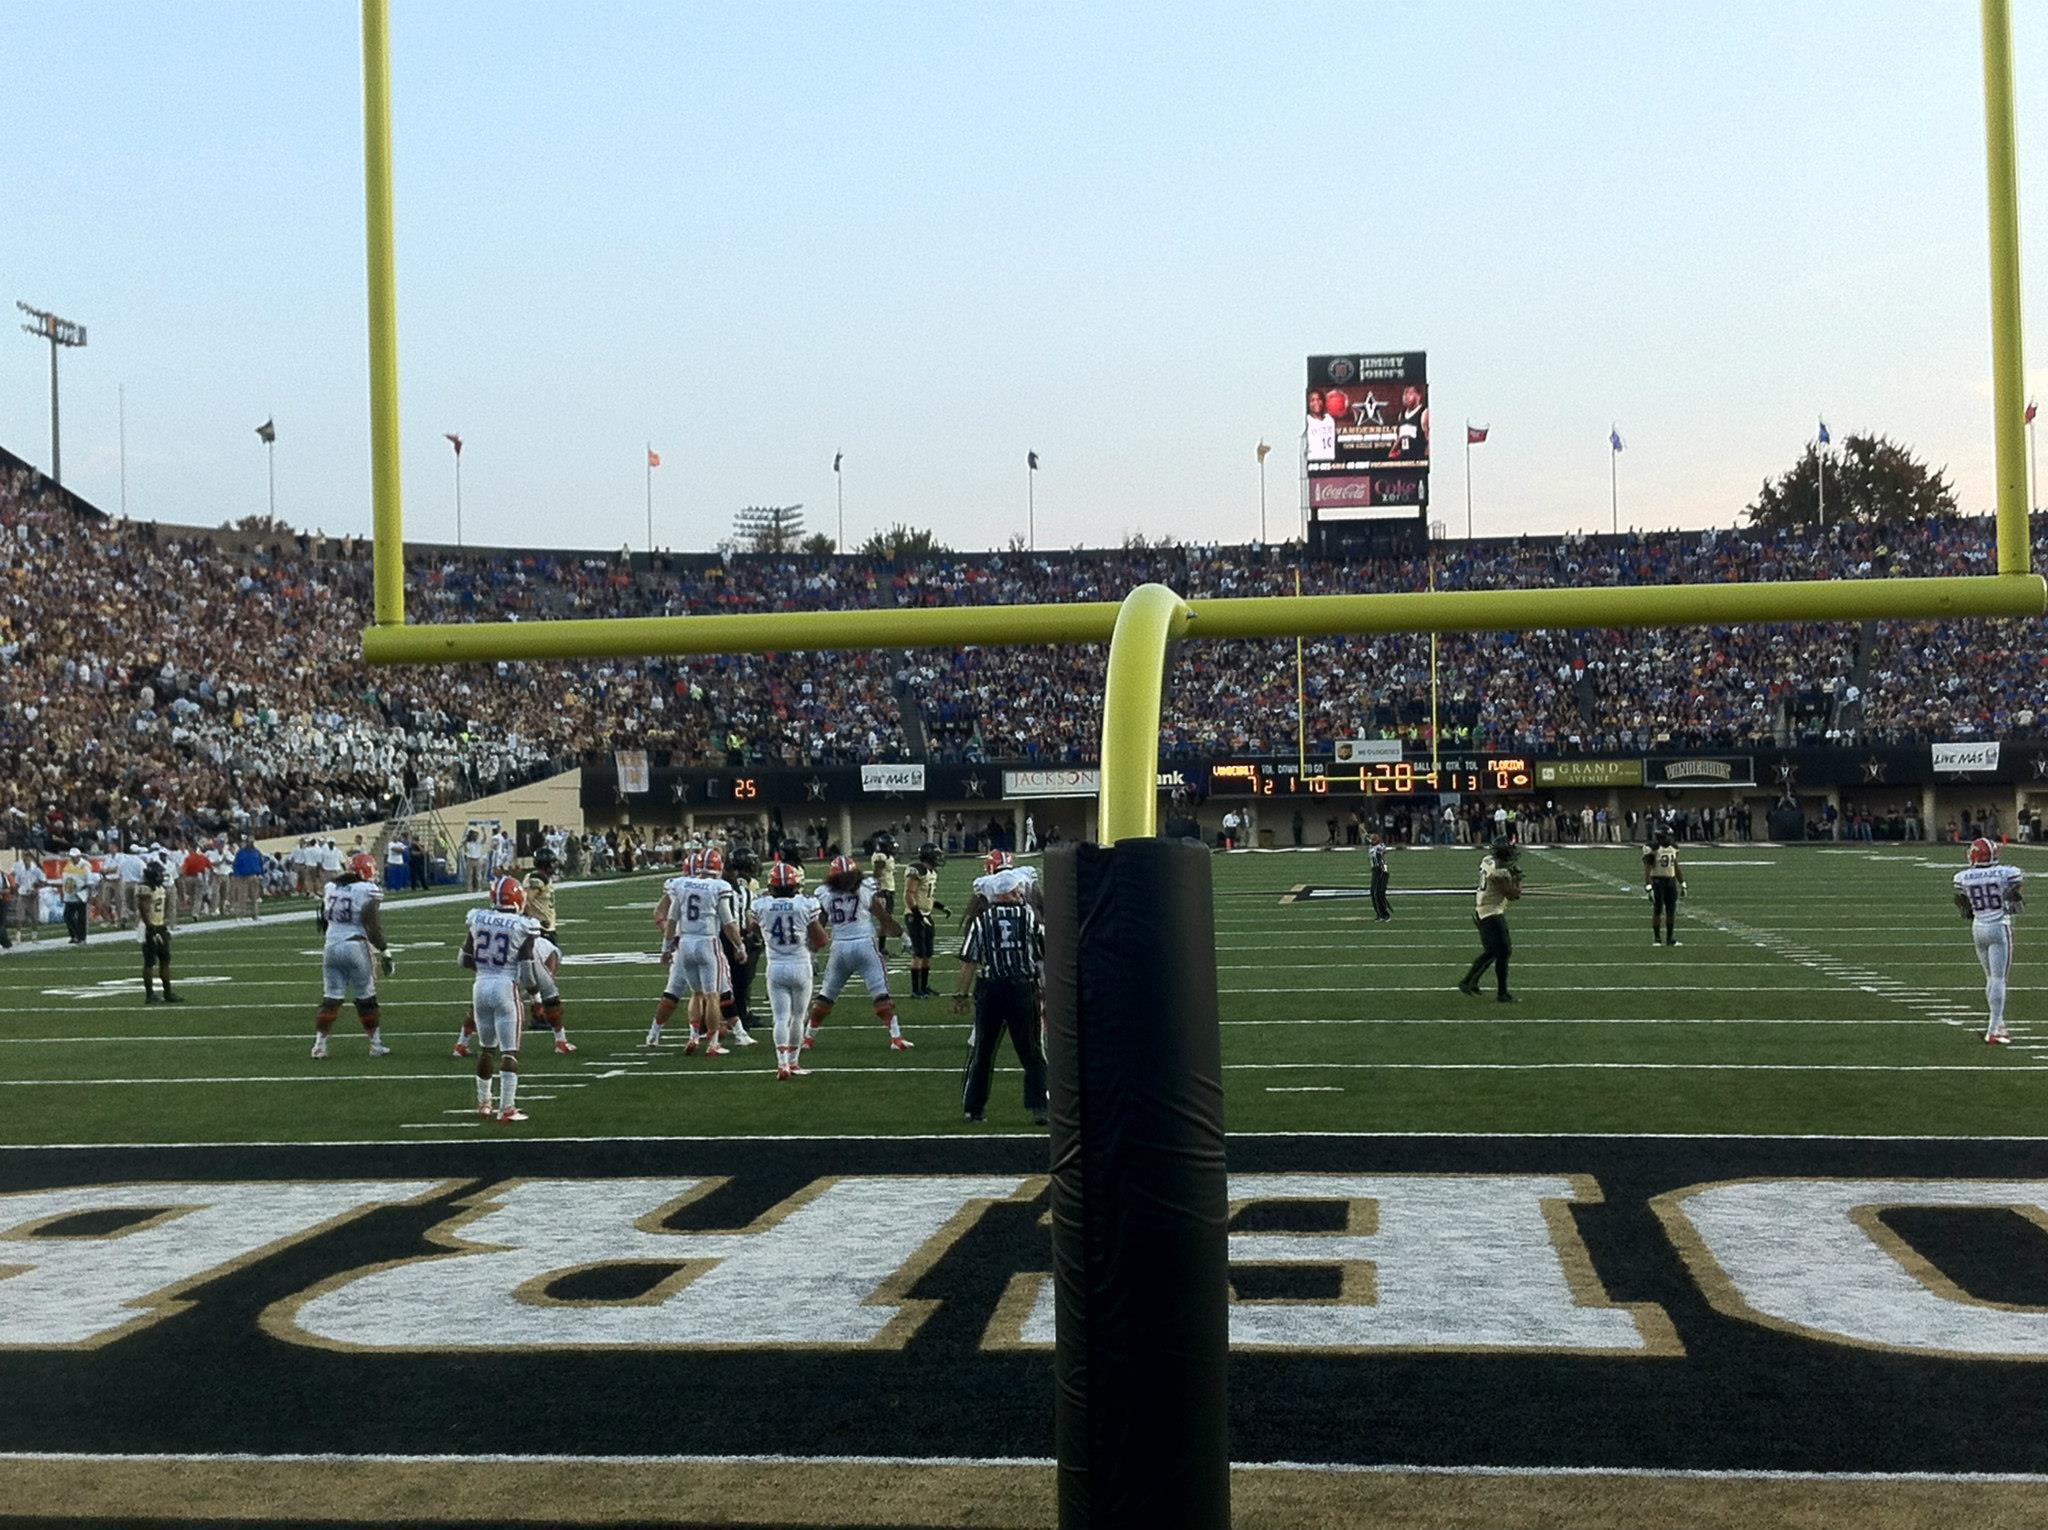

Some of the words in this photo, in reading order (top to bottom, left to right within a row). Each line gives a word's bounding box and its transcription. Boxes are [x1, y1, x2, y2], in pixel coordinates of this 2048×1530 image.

[1360, 357, 1404, 370] JIMMY
[1360, 369, 1405, 382] JOHN'S
[1322, 483, 1367, 500] Coca-Cola
[1374, 480, 1416, 496] Coke
[1313, 763, 1324, 773] GO
[1414, 762, 1430, 771] BALL
[1558, 762, 1619, 775] GRAND
[1012, 771, 1095, 788] JACKSON
[1156, 770, 1185, 785] ank
[1468, 775, 1477, 791] 3
[1568, 774, 1609, 784] AVENUE
[735, 779, 756, 797] 25
[328, 896, 352, 923] 73
[687, 893, 701, 921] 6
[829, 895, 859, 924] 67
[771, 915, 798, 945] 41
[474, 929, 510, 967] 23
